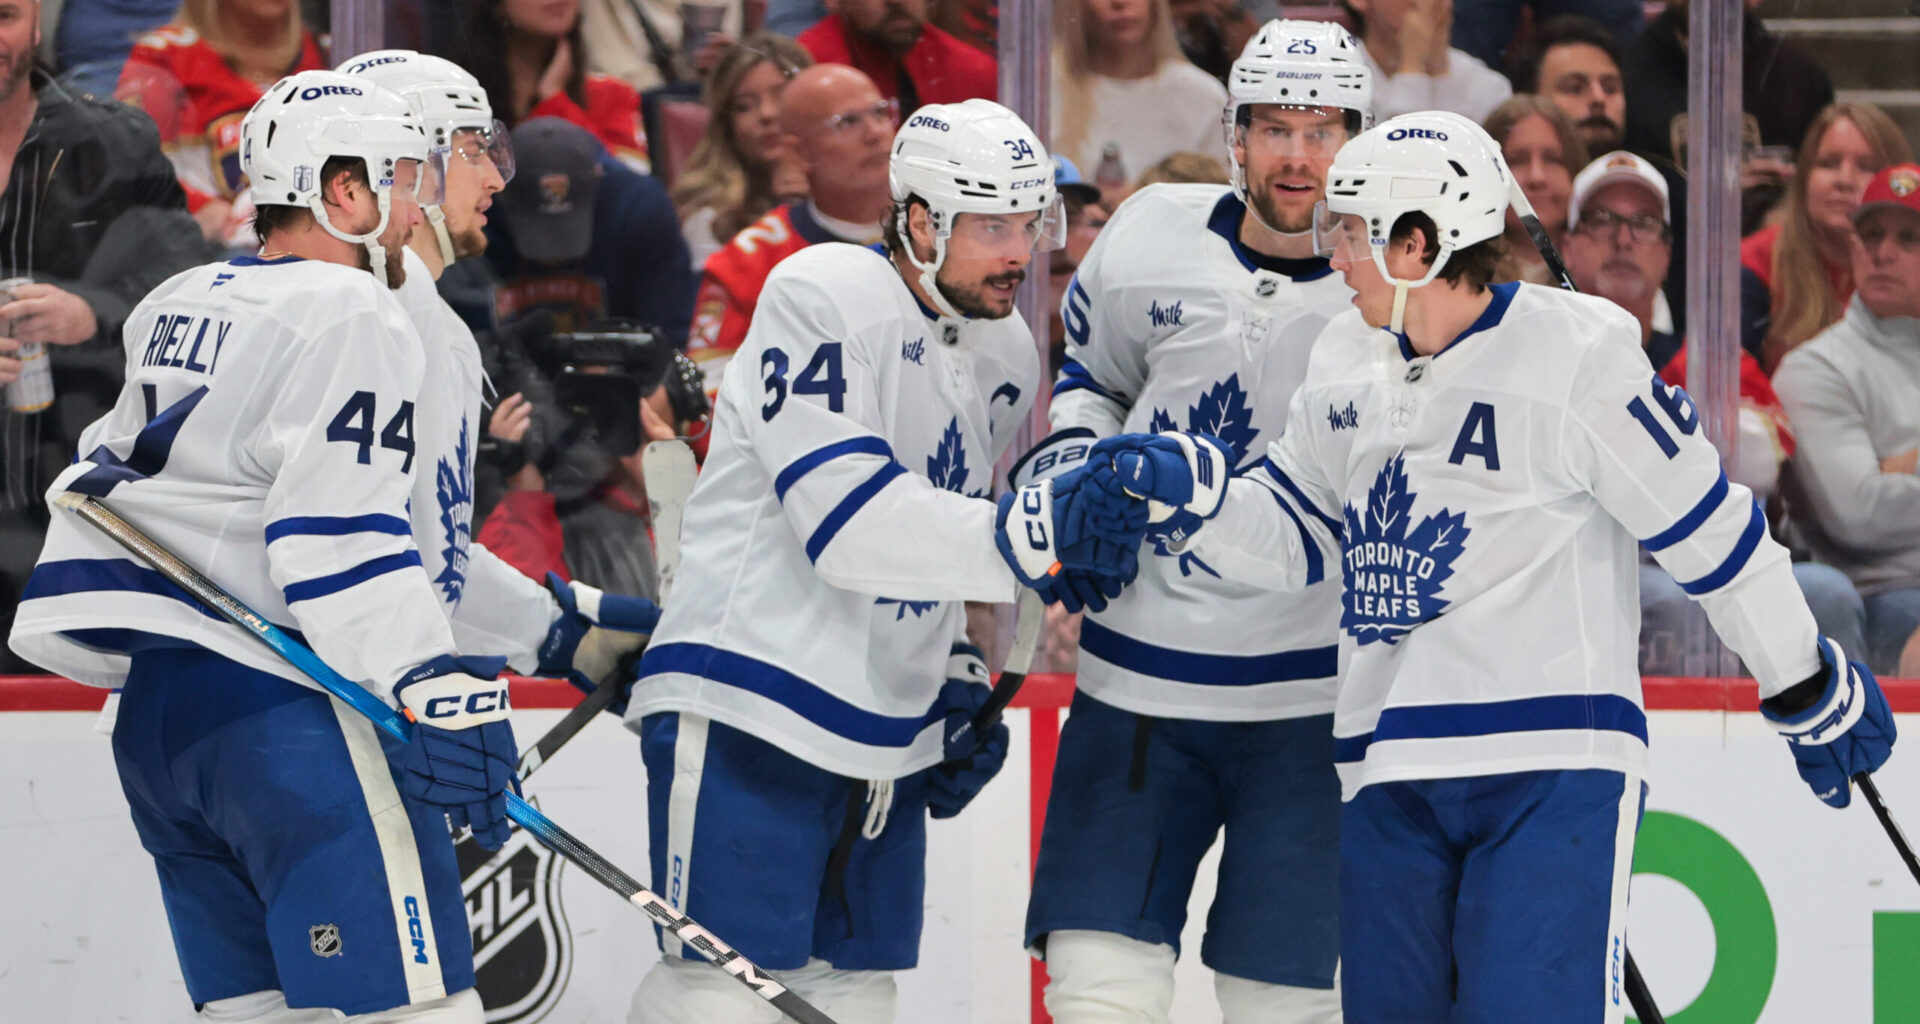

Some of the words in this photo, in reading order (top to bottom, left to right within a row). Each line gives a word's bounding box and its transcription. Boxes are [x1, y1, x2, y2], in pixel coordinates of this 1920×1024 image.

[347, 55, 408, 74] OREO
[1286, 38, 1318, 55] 25
[300, 84, 364, 101] OREO
[909, 115, 951, 133] OREO
[1003, 138, 1035, 161] 34
[1386, 128, 1449, 142] OREO
[1009, 177, 1047, 190] CCM
[1063, 271, 1092, 347] 5
[141, 313, 233, 376] RIELLY
[760, 341, 848, 424] 34
[325, 389, 416, 475] 44
[1447, 401, 1502, 472] A
[1625, 372, 1700, 461] 16
[1022, 482, 1050, 552] CC
[1345, 541, 1436, 580] TORONTO
[1354, 570, 1418, 597] MAPLE
[1354, 593, 1421, 619] LEAFS
[466, 865, 530, 942] HL
[403, 895, 430, 965] CCM
[629, 888, 788, 1001] CCM
